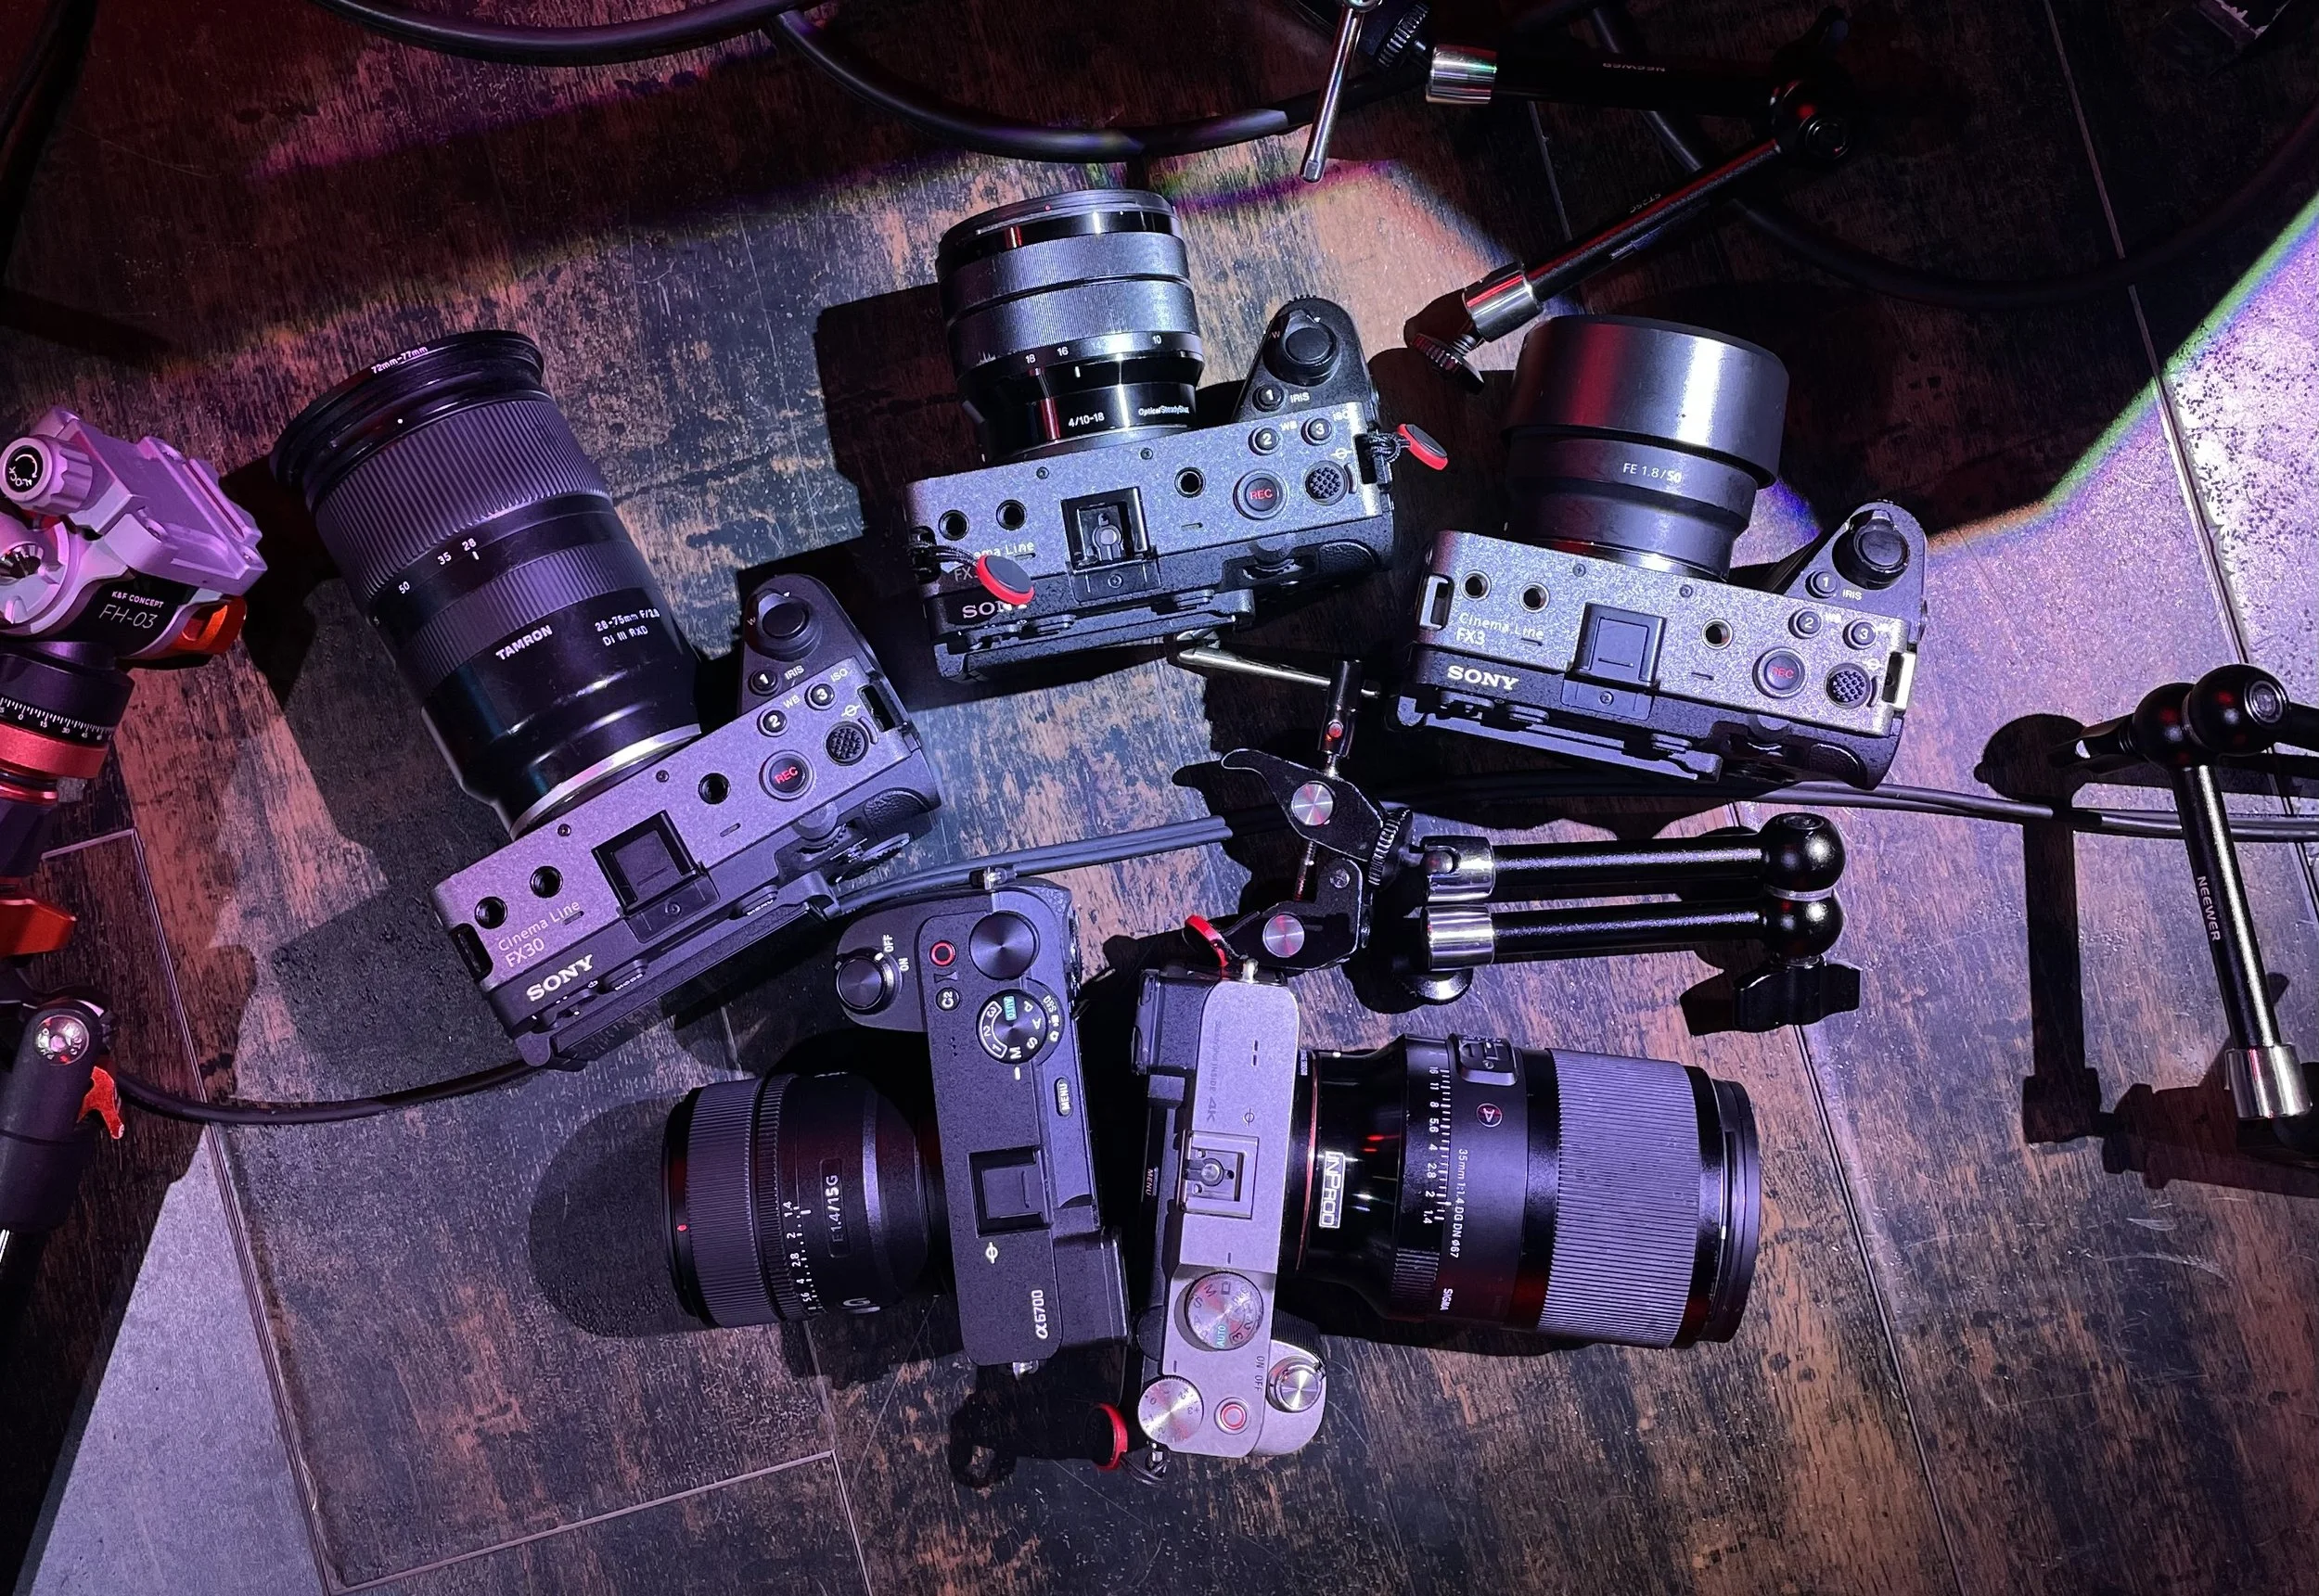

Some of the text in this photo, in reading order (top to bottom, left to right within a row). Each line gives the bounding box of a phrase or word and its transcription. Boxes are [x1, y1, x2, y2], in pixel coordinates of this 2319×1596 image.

[1025, 353, 1036, 364] 18
[1057, 346, 1069, 357] 16
[1152, 334, 1162, 345] 10
[371, 346, 429, 374] 72mm-77mm
[1265, 389, 1311, 404] 1 IRIS
[1068, 412, 1105, 428] 4/10-18
[1262, 432, 1273, 446] 2
[1314, 422, 1325, 437] 3
[1622, 462, 1683, 484] FE 1.8/50
[1249, 488, 1274, 501] REC
[461, 537, 477, 552] 28
[1005, 542, 1034, 555] Line
[437, 551, 452, 566] 35
[398, 581, 411, 594] 50
[1822, 576, 1863, 601] 1 IRIS
[111, 591, 165, 608] K&F CONCEPT
[962, 599, 1028, 619] SON
[98, 604, 158, 630] FH-03
[594, 612, 639, 632] 28-75mm
[1458, 612, 1545, 641] Cinema Line
[628, 625, 648, 638] RXD
[1455, 626, 1486, 646] FX3
[1804, 616, 1815, 630] 2
[1859, 628, 1870, 640] 3
[495, 624, 554, 661] TAMRON
[759, 664, 805, 684] 1 IRIS
[1447, 664, 1519, 692] SONY
[1772, 666, 1795, 680] REC
[768, 668, 850, 728] 2 WB 3 ISO
[774, 766, 799, 785] REC
[2197, 875, 2222, 942] NEEWER
[498, 901, 581, 951] Cinema Line
[505, 938, 545, 968] FX30
[882, 934, 894, 953] OFF
[898, 957, 910, 972] ON
[526, 953, 594, 1002] SONY
[942, 990, 955, 1009] C2
[1005, 997, 1017, 1019] AUTO
[1023, 1000, 1034, 1013] P
[982, 1006, 1002, 1053] 1 2 3
[1031, 1017, 1042, 1030] A
[1026, 1036, 1039, 1049] S
[1009, 1045, 1022, 1060] M
[1429, 1066, 1439, 1075] 16
[1429, 1082, 1440, 1091] 11
[1058, 1082, 1070, 1112] MENU
[1206, 1096, 1217, 1123] 4K
[1429, 1117, 1440, 1133] 5.6
[1427, 1162, 1438, 1179] 2.8
[1456, 1148, 1468, 1180] 35mm
[1145, 1168, 1154, 1196] MENU
[1425, 1190, 1436, 1198] 2
[1454, 1181, 1467, 1205] 1:1.4
[782, 1200, 793, 1218] 1.4
[1423, 1209, 1434, 1224] 1.4
[1454, 1206, 1465, 1221] DG
[786, 1231, 796, 1239] 2
[1452, 1222, 1463, 1238] DN
[789, 1252, 801, 1268] 2.8
[1204, 1283, 1217, 1297] M
[1440, 1287, 1454, 1311] SIGMA
[1193, 1296, 1204, 1309] S
[1215, 1324, 1227, 1347] AUTO
[1232, 1332, 1244, 1343] 3
[1243, 1320, 1254, 1331] 2
[1253, 1355, 1266, 1393] ON OFF
